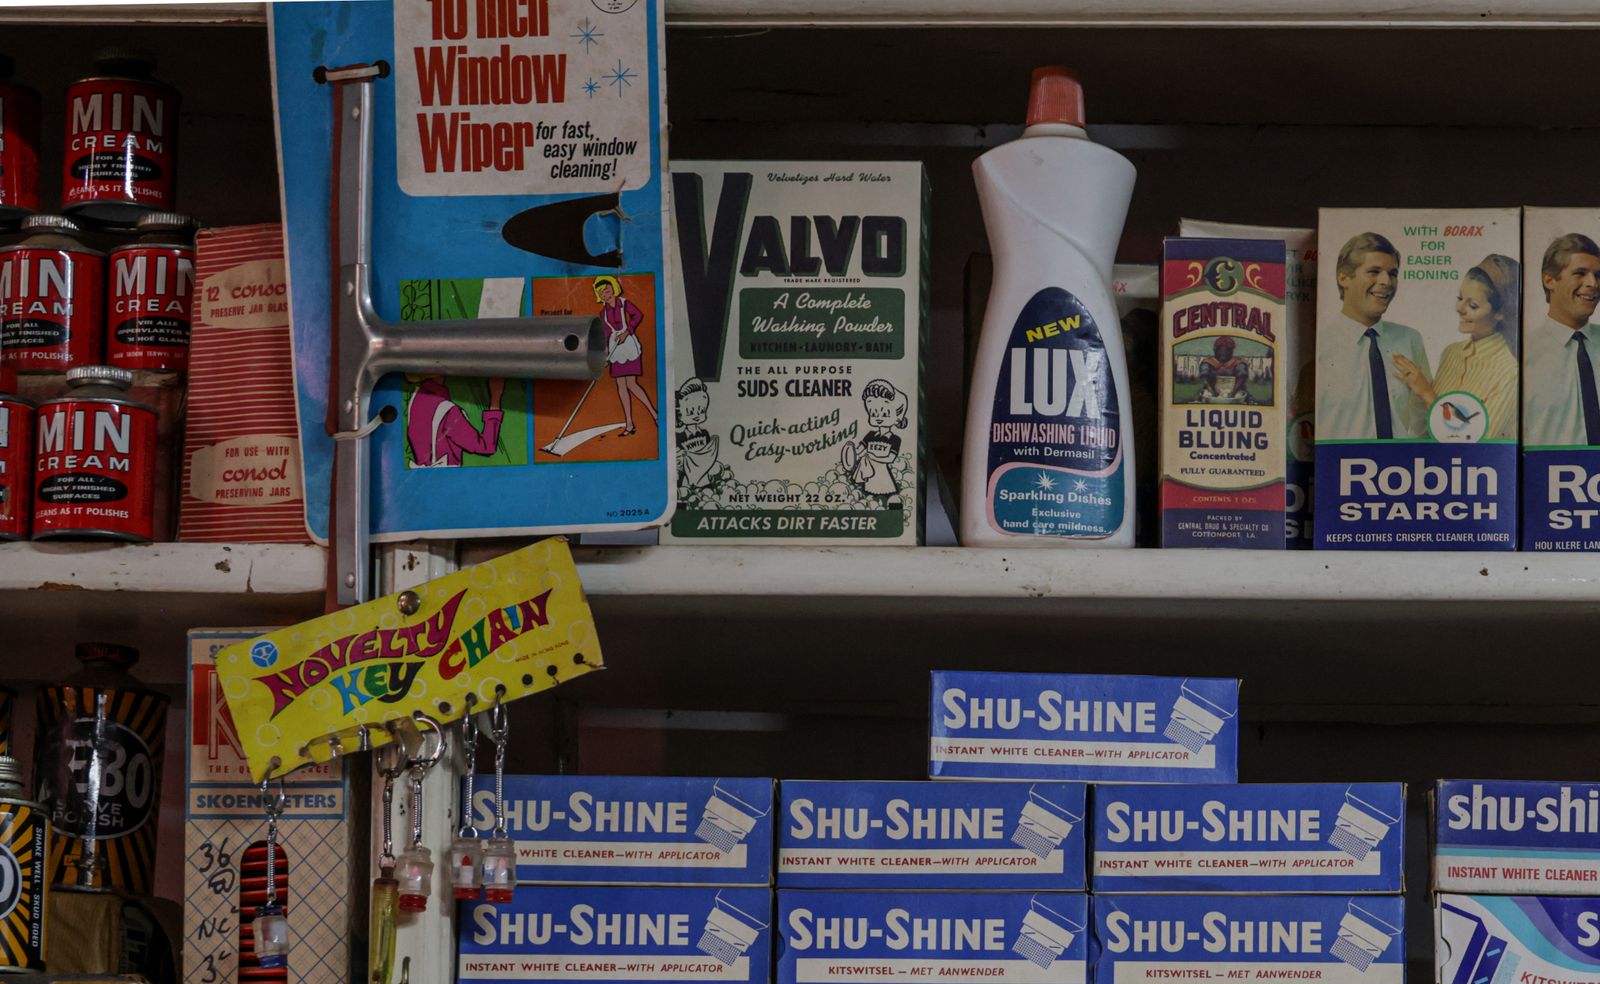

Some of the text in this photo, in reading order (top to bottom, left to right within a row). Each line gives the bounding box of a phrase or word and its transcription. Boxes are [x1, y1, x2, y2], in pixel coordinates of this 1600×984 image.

[414, 46, 566, 107] Window
[72, 94, 163, 137] MIN
[536, 120, 594, 139] for fast,
[71, 134, 163, 154] CREAM
[417, 112, 534, 173] Wiper
[543, 138, 637, 159] easy window
[550, 159, 617, 179] cleaning!
[1404, 225, 1484, 237] WITH BORAX
[1421, 241, 1445, 251] FOR
[1407, 255, 1451, 266] EASIER
[1403, 270, 1459, 281] IRONING
[773, 293, 872, 311] A Complete
[752, 316, 893, 335] Washing Powder
[1026, 315, 1082, 342] NEW
[1173, 303, 1275, 340] CENTRAL
[737, 379, 852, 398] SUDS CLEANER
[1010, 348, 1099, 417] LUX
[730, 407, 840, 444] Quick-acting
[1187, 409, 1263, 431] LIQUID
[745, 421, 859, 463] Easy-working
[993, 422, 1116, 449] DISHWASHING LIQUID
[1178, 430, 1268, 450] BLUING
[225, 446, 289, 458] FOR USE WITH
[1014, 447, 1095, 460] with Dermasil
[1189, 451, 1256, 462] Concentrated
[223, 459, 286, 482] consol
[1339, 458, 1497, 496] Robin
[215, 486, 290, 499] PRESERVING JARS
[729, 493, 754, 504] NET
[758, 493, 800, 504] WEIGHT
[803, 493, 817, 503] 22
[999, 488, 1112, 505] Sparkling Dishes
[1339, 503, 1497, 520] STARCH
[697, 515, 877, 531] ATTACKS DIRT FASTER
[1326, 533, 1353, 543] KEEPS
[1356, 533, 1392, 543] CLOTHES
[1477, 533, 1509, 543] LONGER
[439, 590, 555, 680] CHAIN
[253, 589, 467, 720] NOVELTY
[1448, 867, 1498, 880] INSTANT
[1502, 868, 1537, 880] WHITE
[1541, 869, 1598, 882] CLEANER
